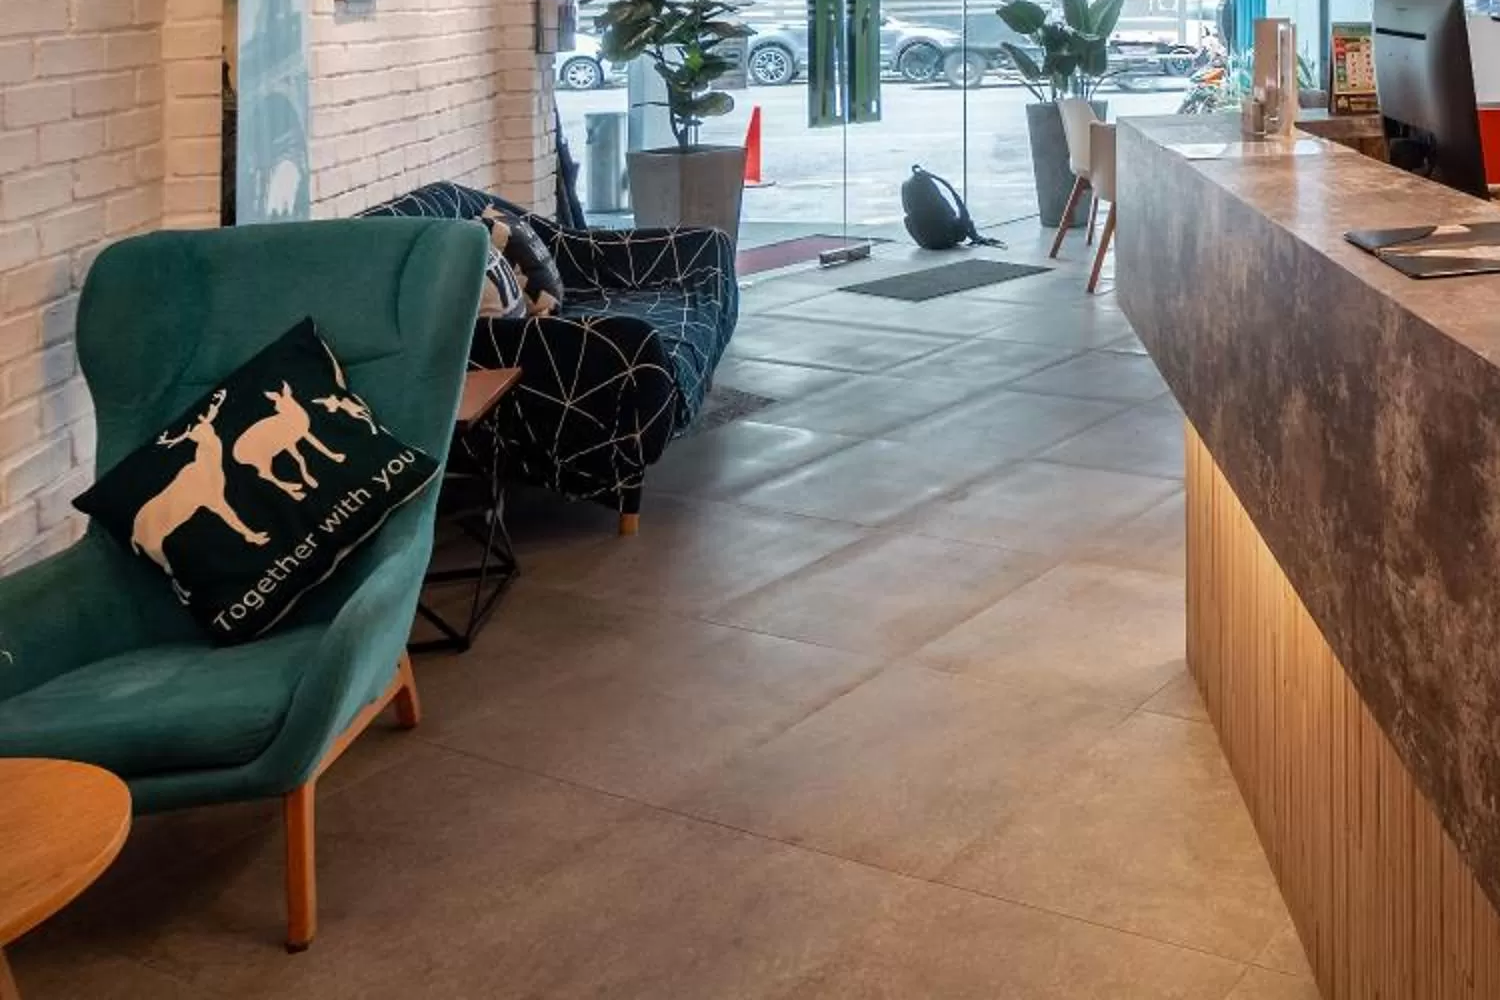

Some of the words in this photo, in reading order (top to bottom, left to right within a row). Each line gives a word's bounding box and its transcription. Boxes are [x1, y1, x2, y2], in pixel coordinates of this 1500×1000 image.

[213, 532, 319, 631] Together
[319, 487, 372, 533] with
[372, 449, 416, 492] you
